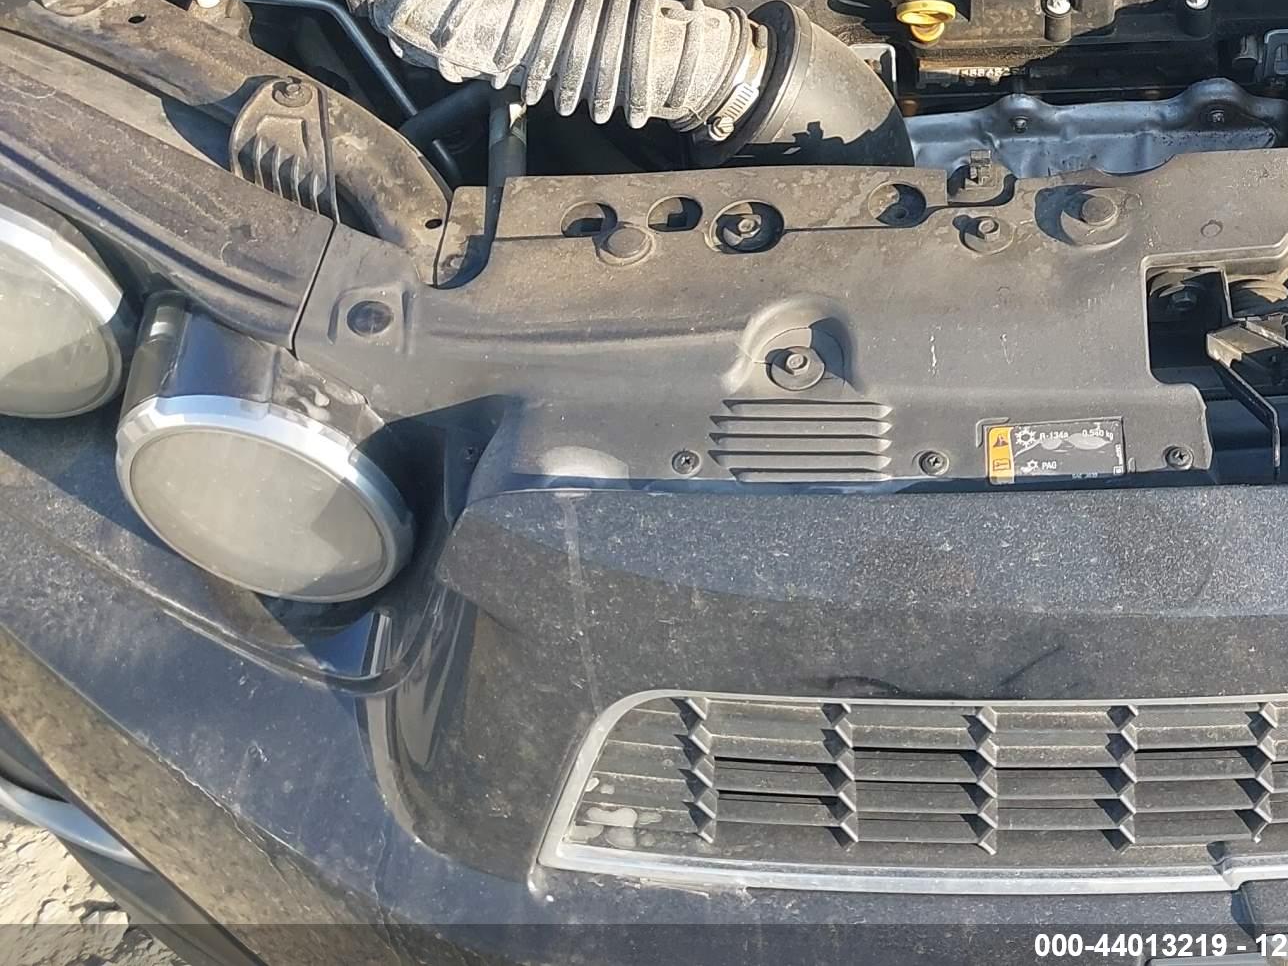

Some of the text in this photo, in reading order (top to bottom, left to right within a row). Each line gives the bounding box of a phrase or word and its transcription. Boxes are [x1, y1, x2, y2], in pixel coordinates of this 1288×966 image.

[1039, 431, 1068, 441] R-134a
[1105, 430, 1114, 441] kg
[1041, 461, 1057, 470] PAG
